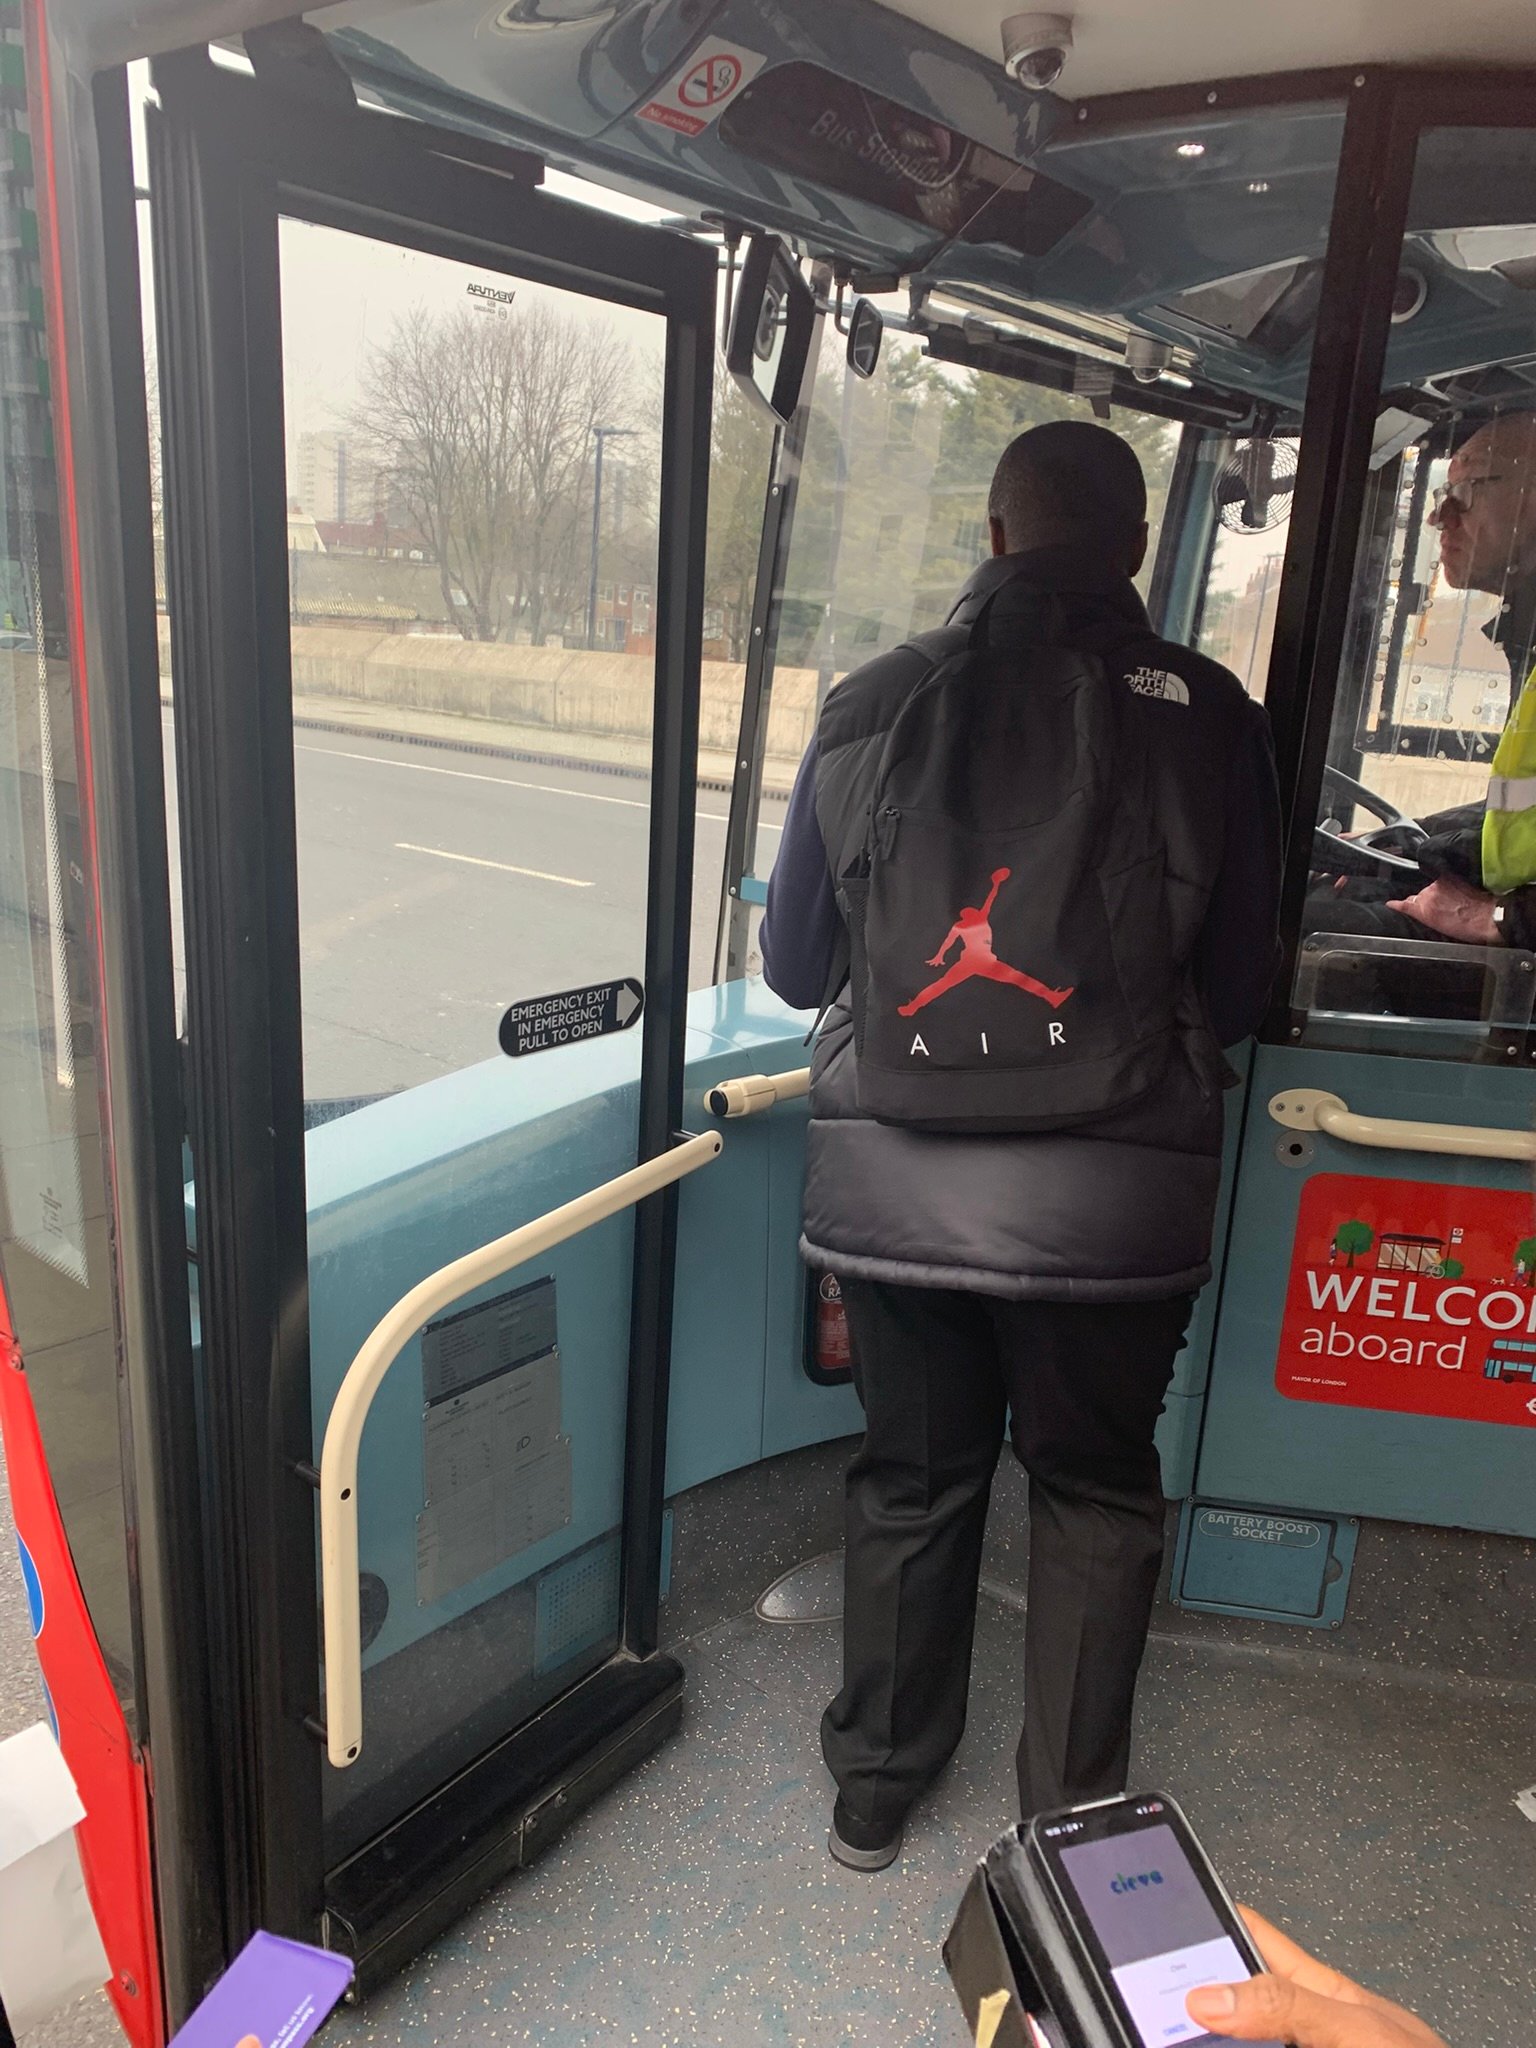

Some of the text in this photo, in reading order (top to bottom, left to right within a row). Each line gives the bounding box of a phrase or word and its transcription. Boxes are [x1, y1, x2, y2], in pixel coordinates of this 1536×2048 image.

[810, 110, 858, 146] Bus
[1123, 674, 1165, 689] ORTH
[1137, 667, 1166, 679] THE
[511, 987, 612, 1022] EMERGENCY EXIT
[518, 1004, 605, 1036] IN EMERGENCY
[519, 1020, 603, 1052] PULL TO OPEN
[1306, 1270, 1536, 1334] WELCO
[1300, 1321, 1467, 1370] aboard
[1321, 1379, 1347, 1387] LONDON
[1208, 1513, 1312, 1535] BATTERY BOOST
[1232, 1526, 1283, 1541] SOCKET
